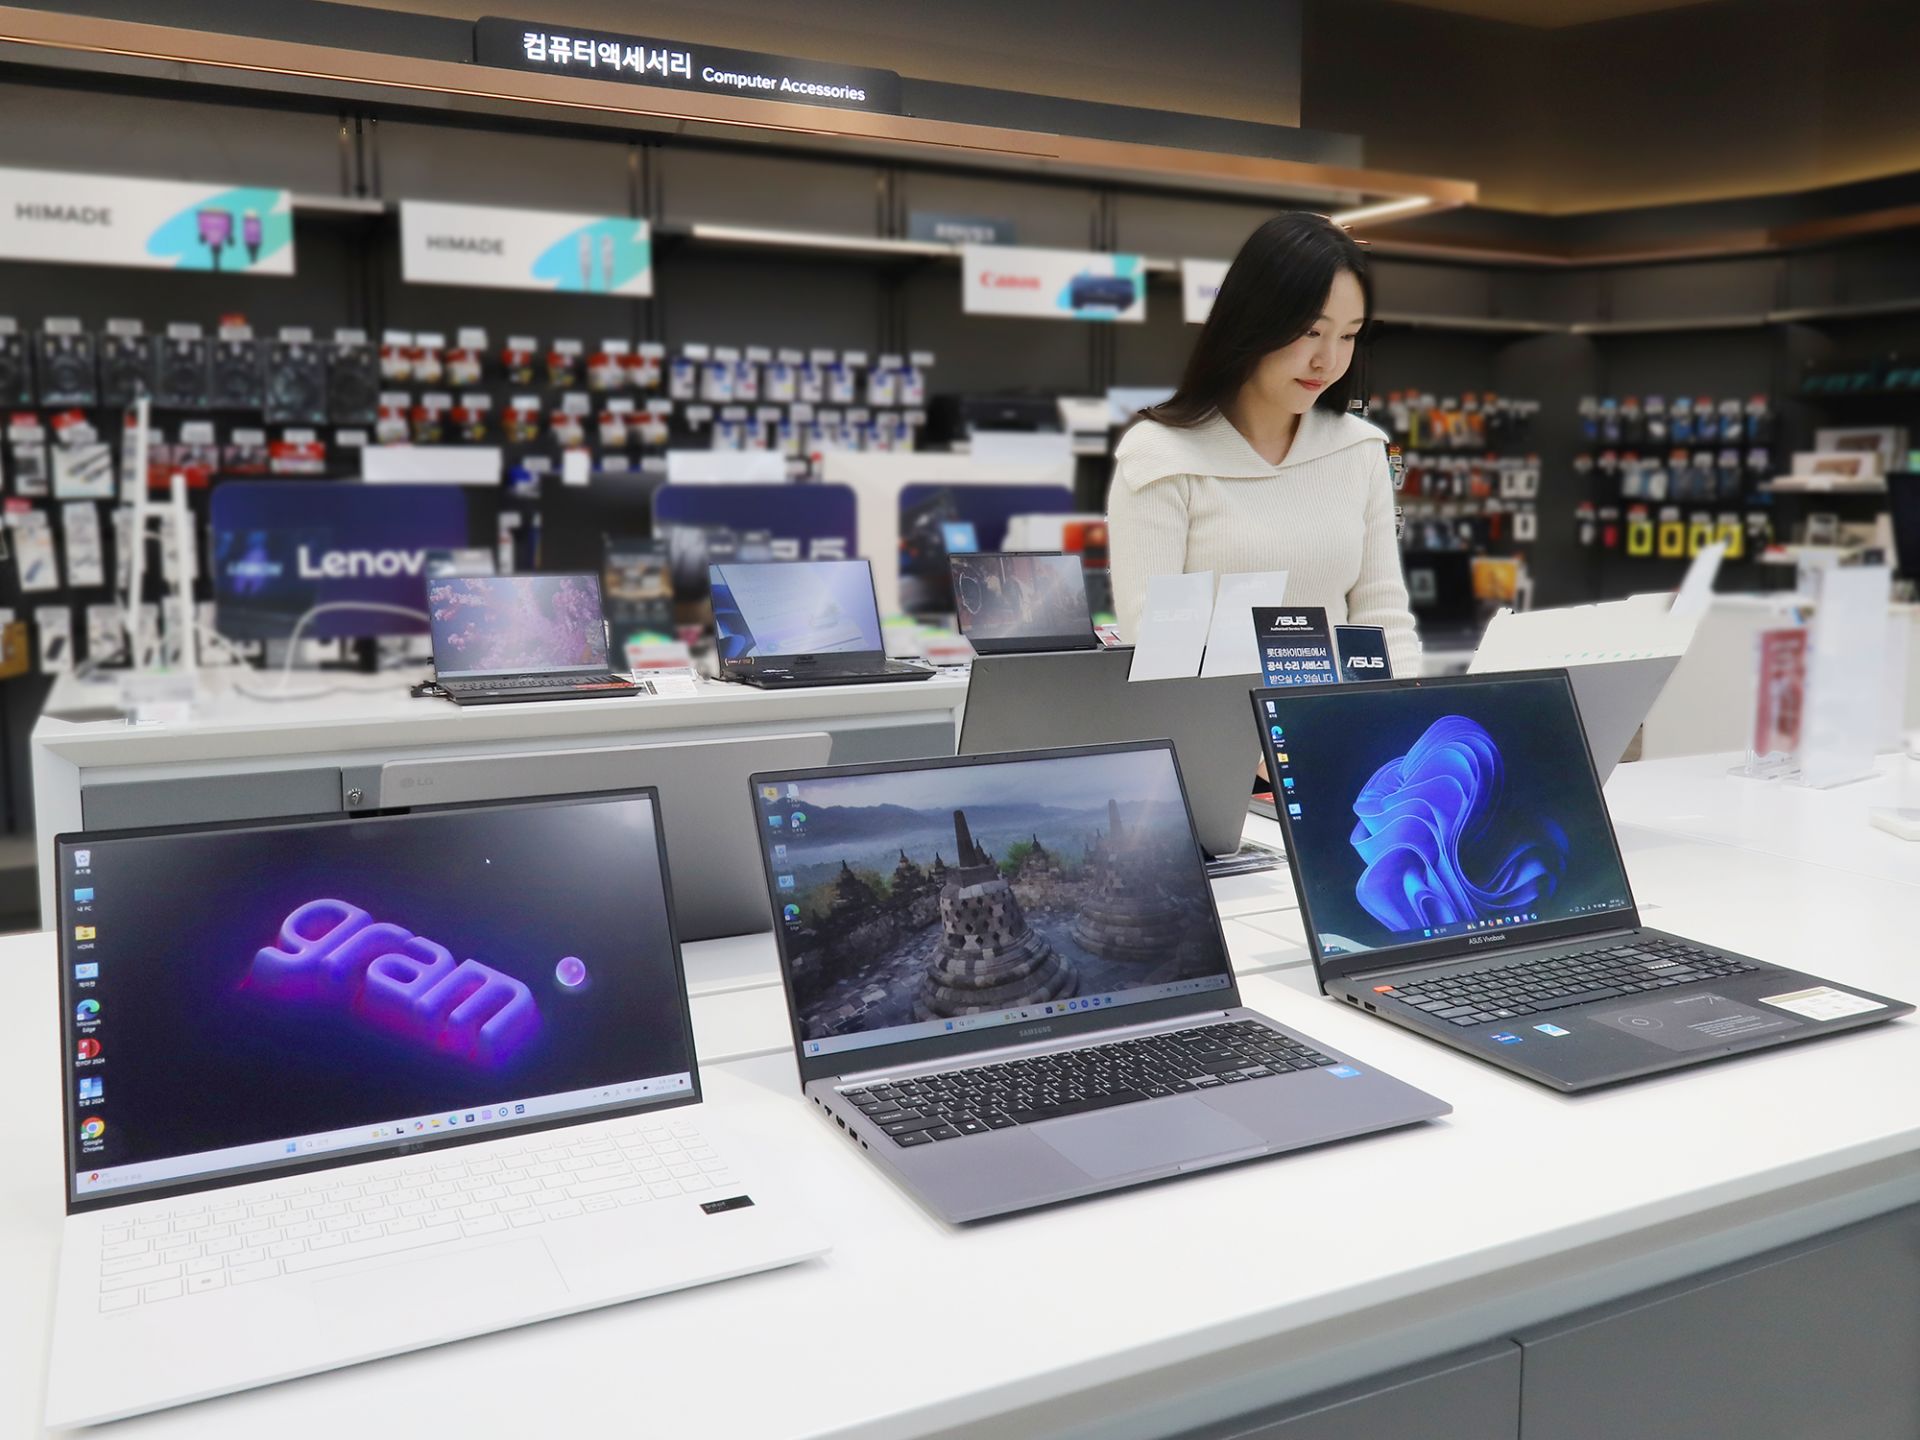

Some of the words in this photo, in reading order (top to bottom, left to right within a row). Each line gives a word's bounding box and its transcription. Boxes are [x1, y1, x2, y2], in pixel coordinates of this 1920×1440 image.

[523, 32, 691, 79] 컴퓨터액세서리
[702, 67, 777, 91] Computer
[780, 77, 866, 101] Accessories
[15, 203, 113, 226] HIMADE
[425, 236, 504, 256] HIMADE
[979, 271, 1041, 289] Canon
[298, 545, 427, 578] Lenov
[1275, 616, 1308, 626] ASUS
[1267, 647, 1327, 658] 롯데하이마트에서
[1267, 661, 1283, 671] 공식
[1284, 661, 1300, 671] 수리
[1301, 660, 1331, 670] 서비스를
[1346, 656, 1385, 669] ASUS
[1269, 674, 1293, 684] 받으실
[1295, 674, 1303, 684] 수
[1303, 673, 1334, 684] 있습니다
[1469, 936, 1483, 945] ASUS
[252, 898, 538, 1062] gram
